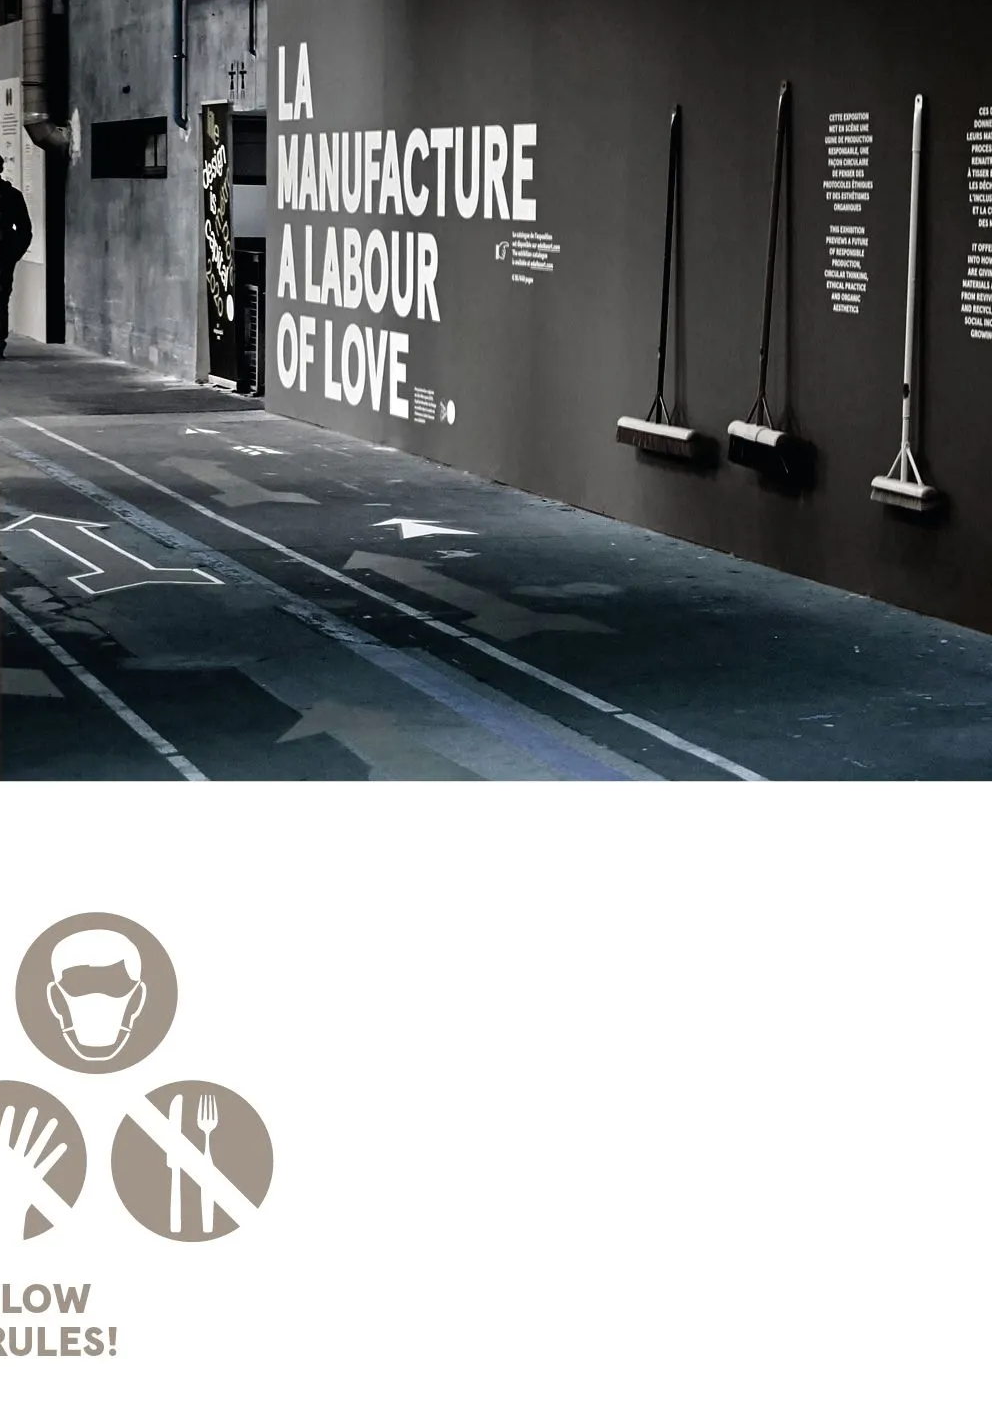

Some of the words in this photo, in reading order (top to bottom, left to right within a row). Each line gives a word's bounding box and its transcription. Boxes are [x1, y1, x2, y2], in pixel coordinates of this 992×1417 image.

[278, 42, 314, 121] LA
[277, 123, 537, 221] MANUFACTURE
[277, 223, 298, 300] A
[304, 224, 441, 322] LABOUR
[276, 312, 316, 393] OF
[324, 319, 409, 419] LOVE
